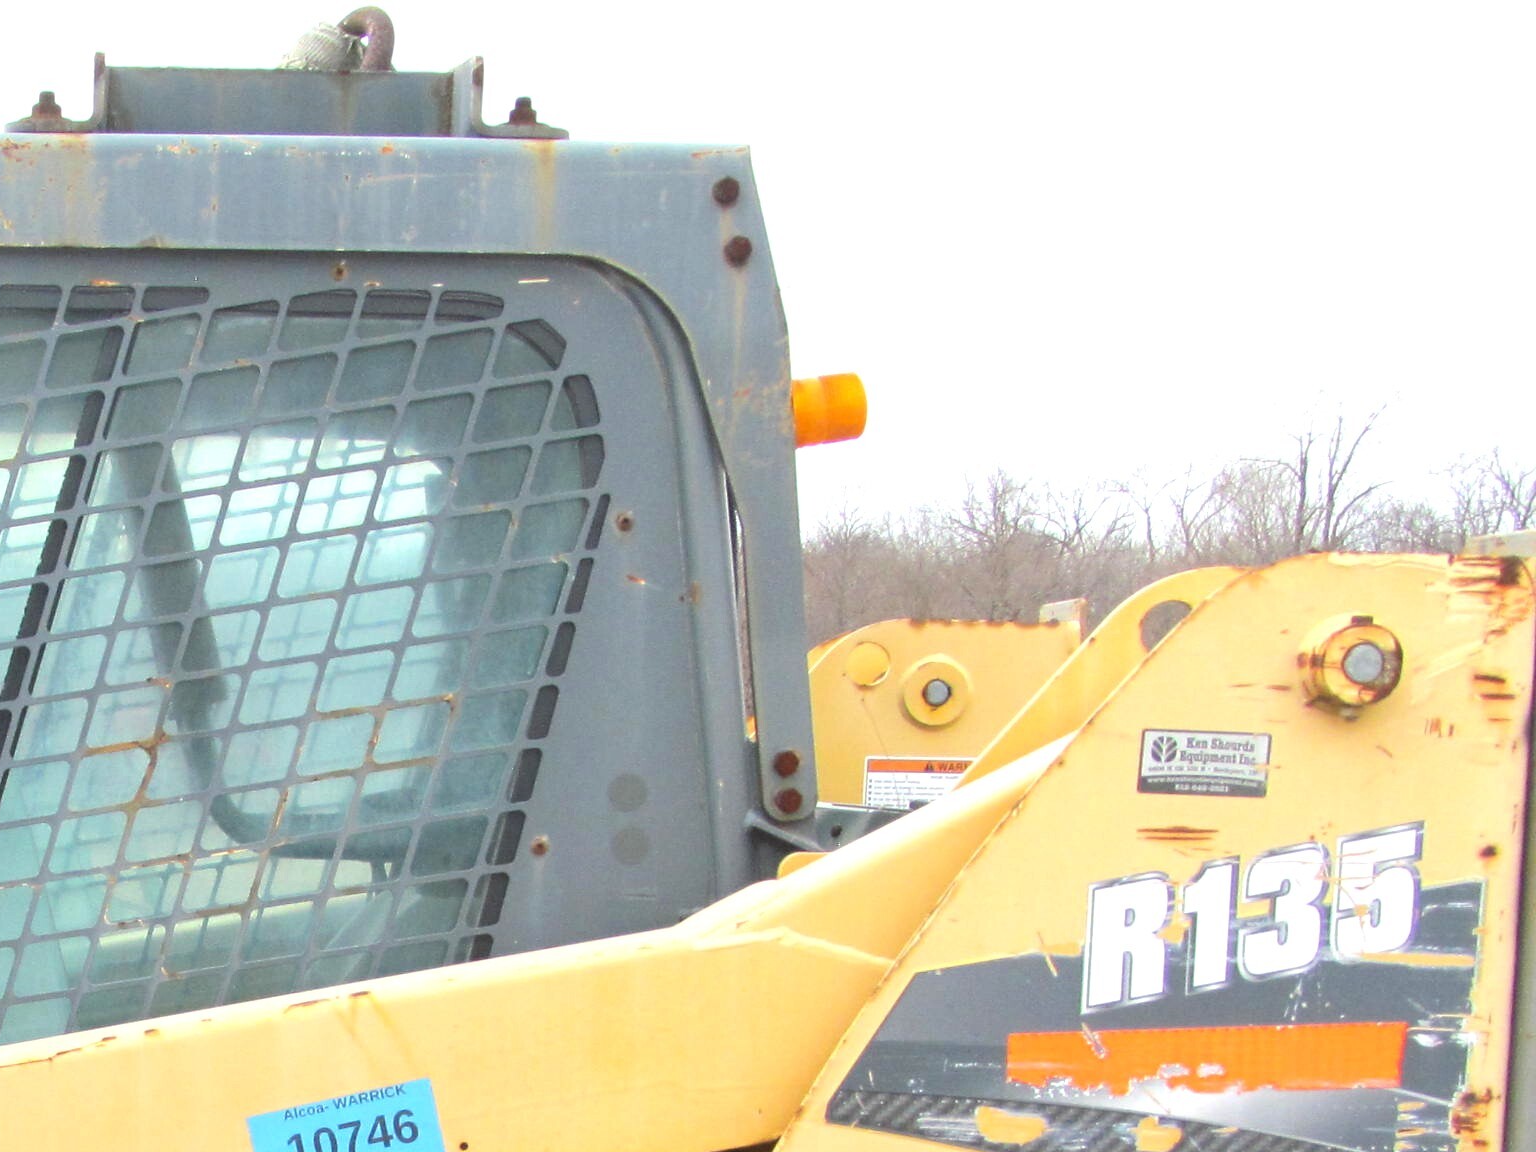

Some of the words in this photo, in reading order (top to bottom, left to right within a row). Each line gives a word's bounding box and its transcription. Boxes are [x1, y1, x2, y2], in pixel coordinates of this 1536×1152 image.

[1186, 737, 1208, 749] Ken
[1180, 750, 1236, 765] Equipment
[1081, 820, 1425, 1014] R135
[284, 1105, 329, 1121] Alcoa-
[333, 1083, 407, 1111] WARRICK
